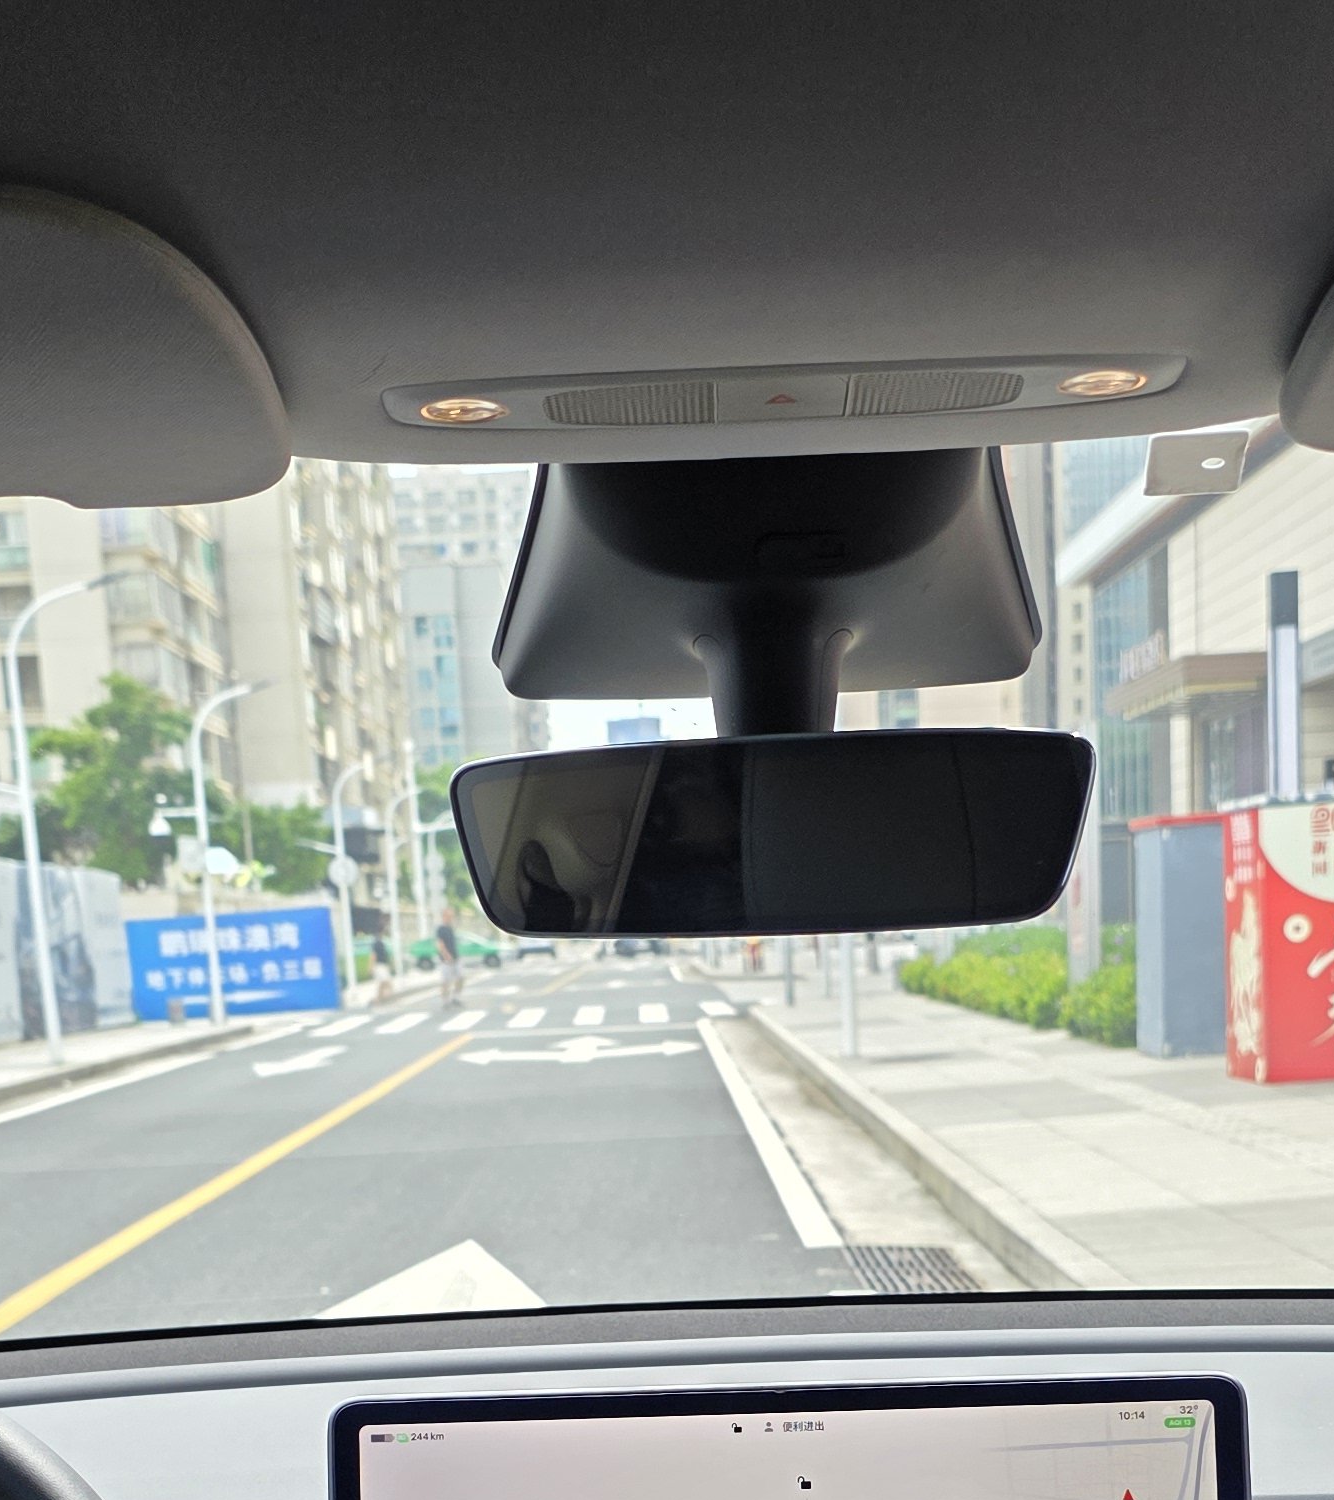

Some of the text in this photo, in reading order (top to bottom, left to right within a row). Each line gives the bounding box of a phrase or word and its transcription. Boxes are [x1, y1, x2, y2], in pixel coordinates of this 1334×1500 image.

[1118, 1405, 1199, 1420] 10:14 32°
[783, 1421, 824, 1432] 便利进出
[410, 1432, 445, 1441] 244 km
